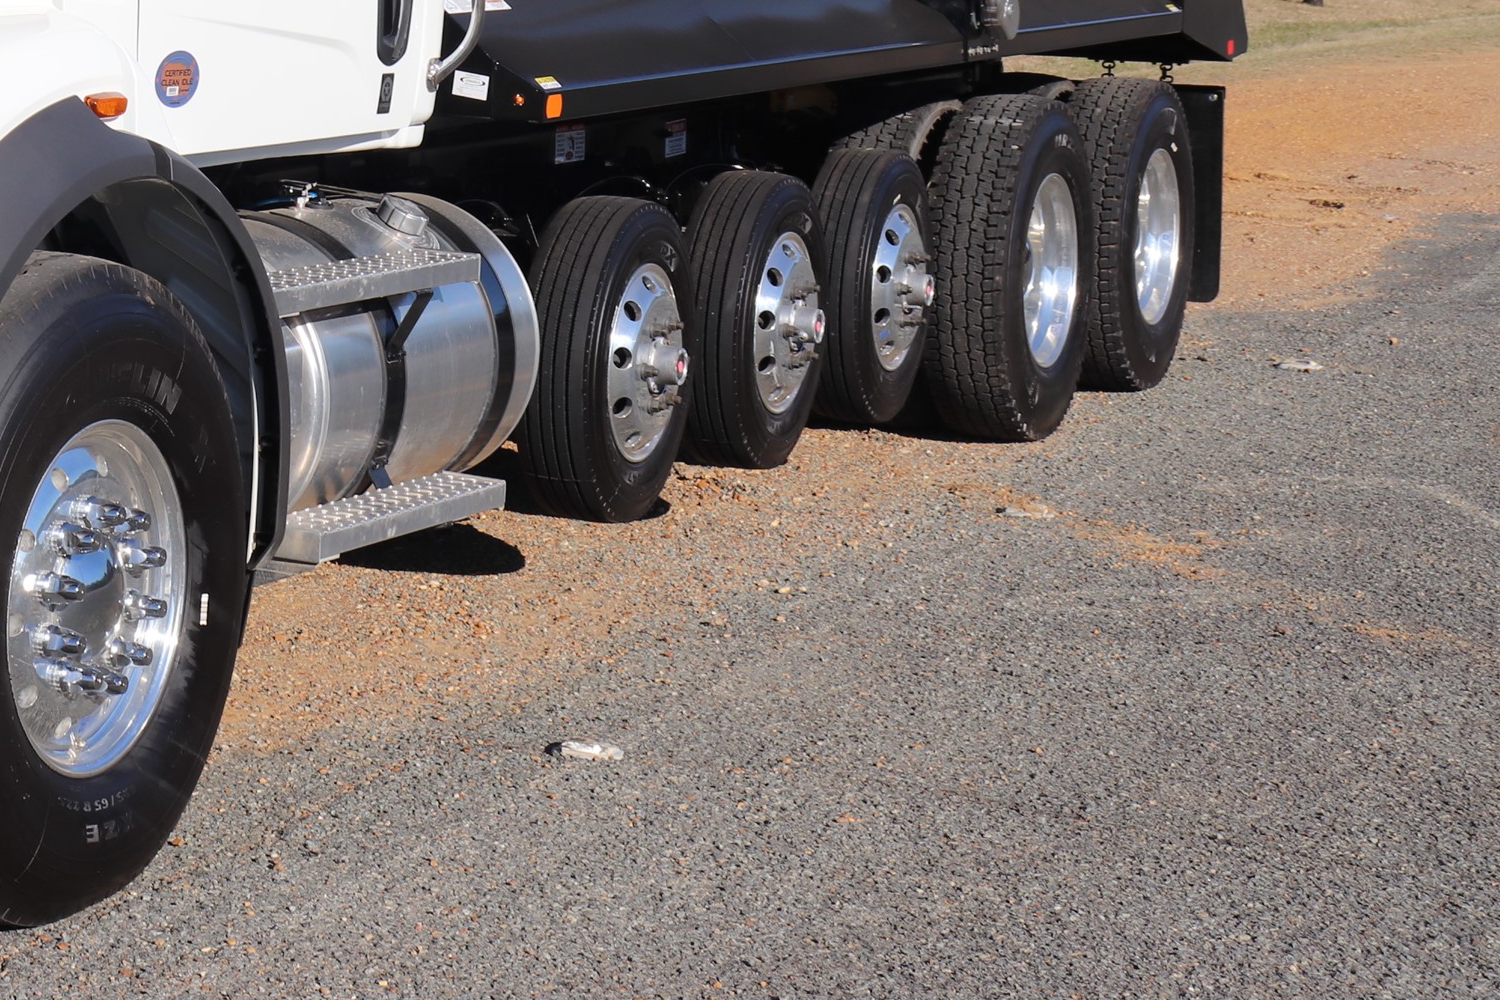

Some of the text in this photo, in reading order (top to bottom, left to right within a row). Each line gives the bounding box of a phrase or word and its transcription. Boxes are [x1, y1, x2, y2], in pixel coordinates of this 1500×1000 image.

[164, 68, 192, 77] CERTIFIED
[161, 77, 194, 87] CLEAN IDLE
